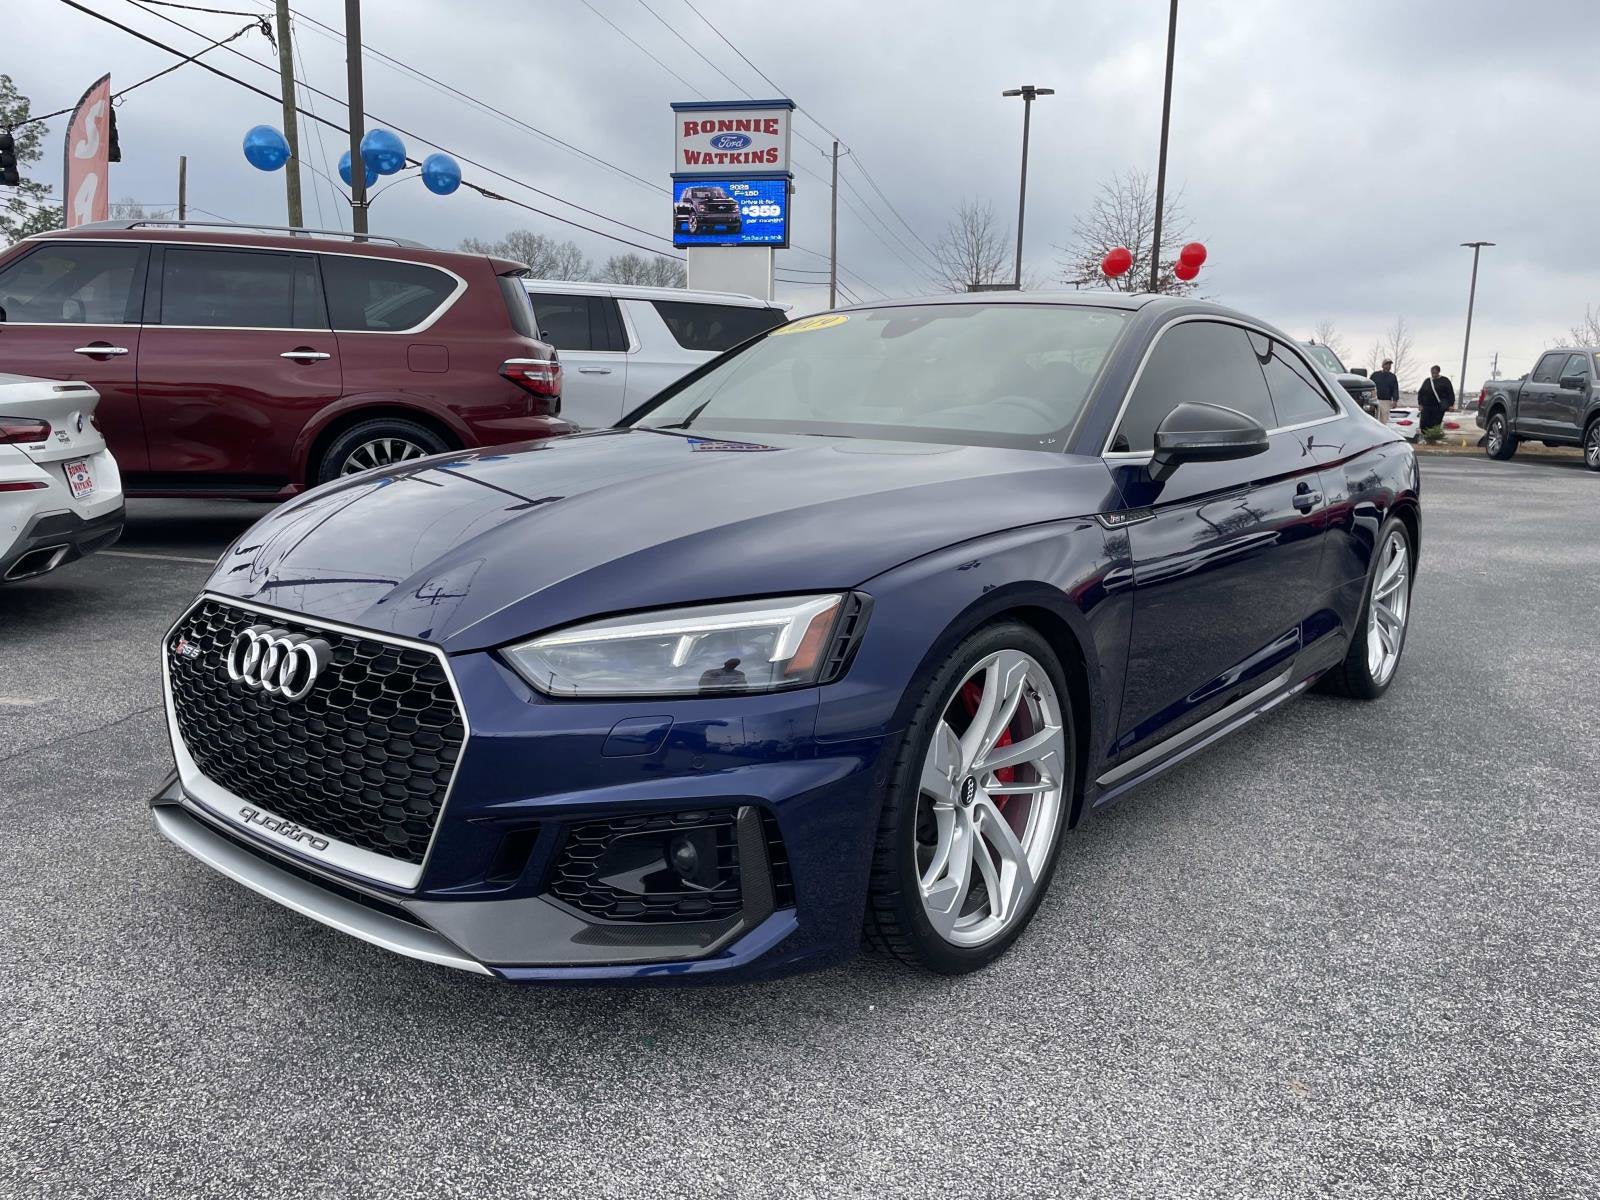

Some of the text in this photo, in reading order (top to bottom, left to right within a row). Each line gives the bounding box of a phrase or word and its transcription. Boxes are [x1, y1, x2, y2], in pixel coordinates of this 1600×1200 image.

[684, 118, 779, 138] RONNIE
[718, 136, 744, 148] Ford
[683, 147, 778, 165] WATKINS
[238, 805, 330, 851] quattro
